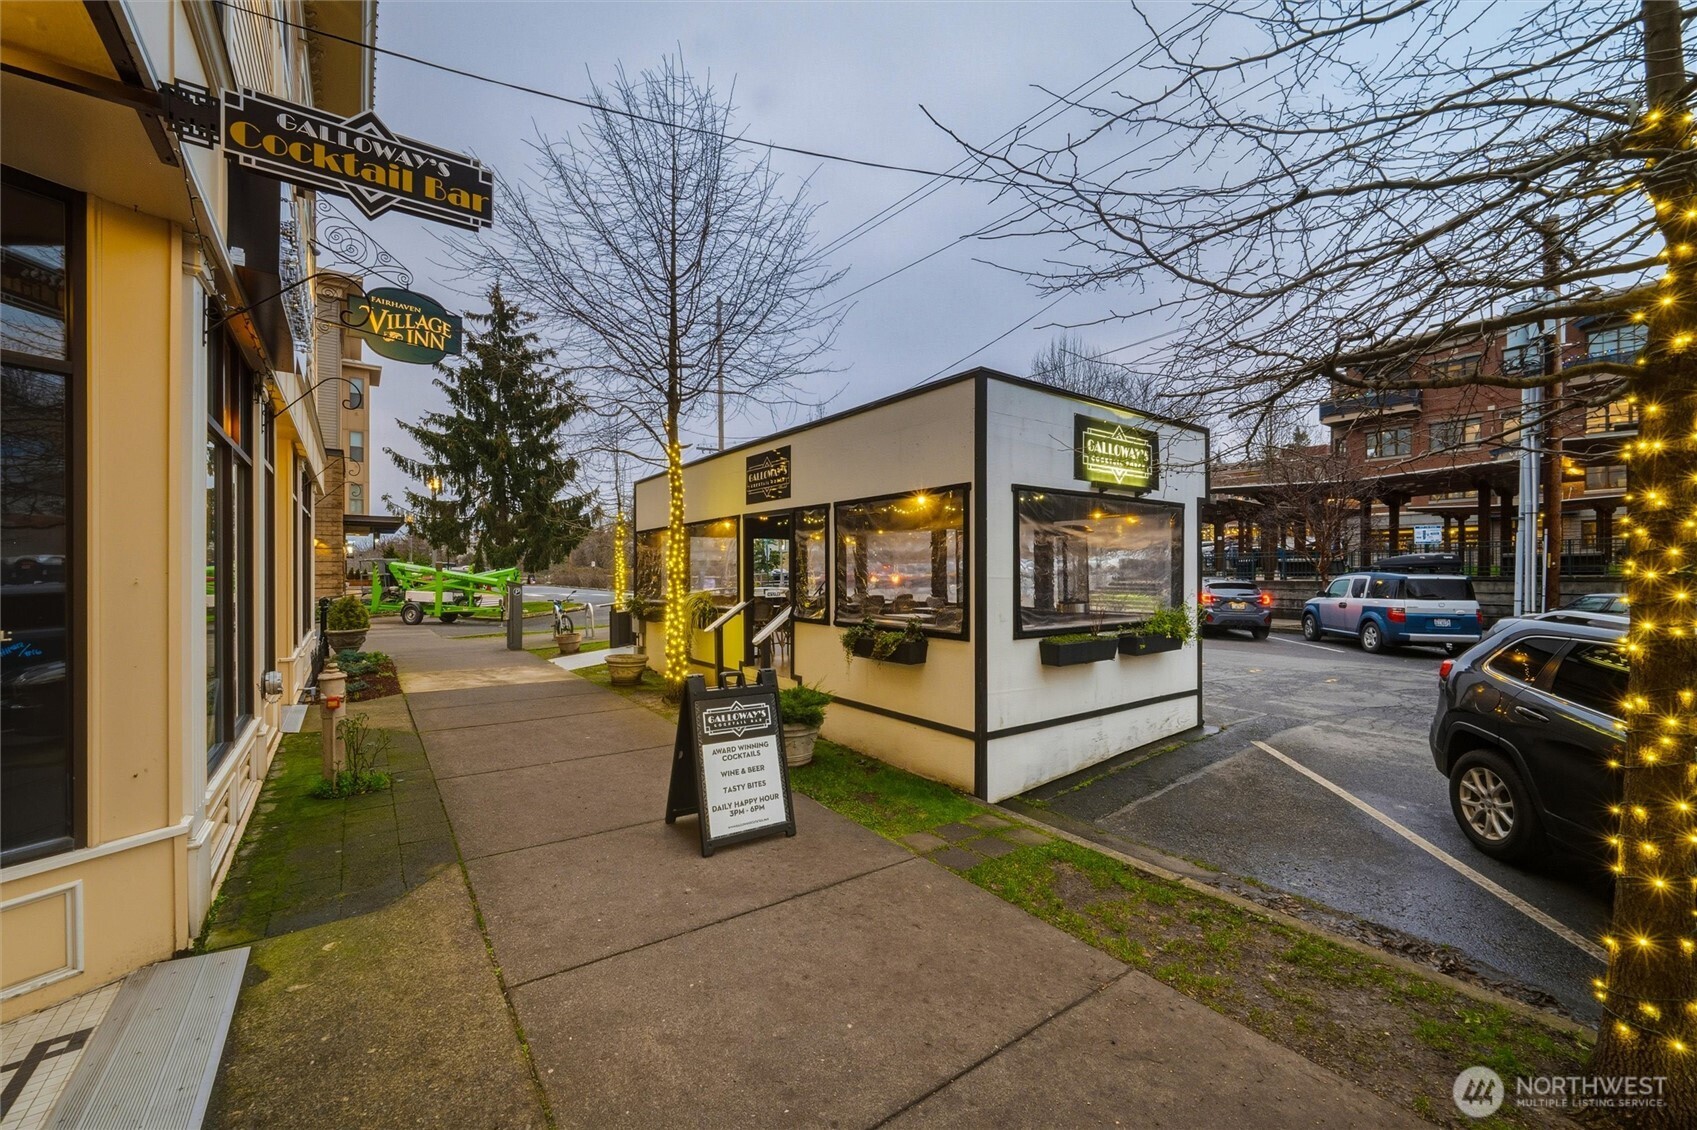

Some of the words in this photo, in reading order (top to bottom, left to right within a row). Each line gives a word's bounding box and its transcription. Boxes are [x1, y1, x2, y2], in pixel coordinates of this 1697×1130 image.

[276, 113, 451, 178] GALLOWAY'S
[229, 121, 413, 193] Cocktail
[424, 175, 489, 213] Bar
[371, 295, 422, 313] FAIRHAVEN
[359, 305, 452, 339] VILLAGE
[407, 329, 445, 351] INN
[1087, 439, 1149, 461] GALLOWAY'S
[707, 709, 767, 724] GALLOWAY'S
[712, 746, 737, 756] AWARD
[737, 741, 769, 751] WINNING
[722, 750, 761, 761] COCKTAILS
[720, 768, 740, 778] WINE
[740, 767, 746, 775] &
[747, 764, 765, 774] BEER
[723, 783, 746, 794] TASTY
[747, 779, 767, 789] BITES
[711, 802, 733, 813] DAILY
[734, 797, 758, 808] HAPPY
[759, 793, 780, 803] HOUR
[729, 807, 745, 817] 3PM
[750, 803, 766, 813] 6PM
